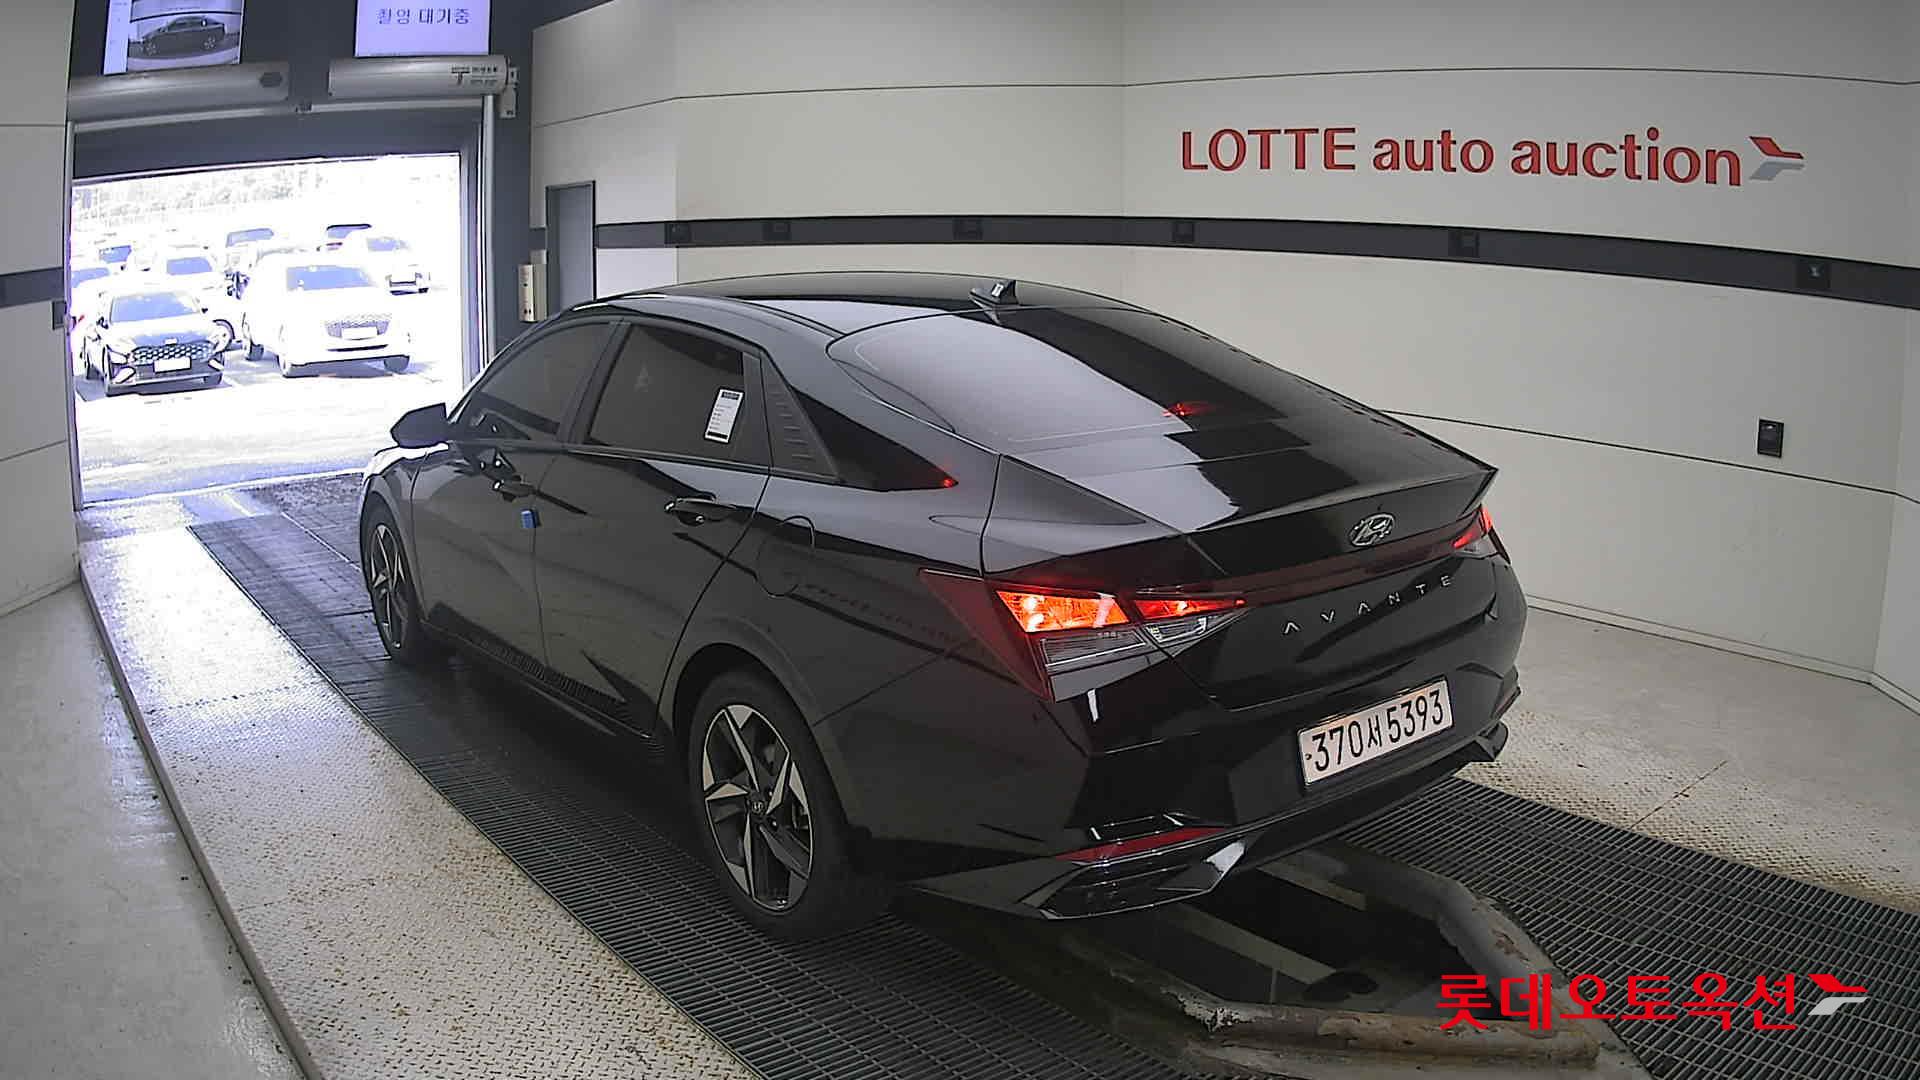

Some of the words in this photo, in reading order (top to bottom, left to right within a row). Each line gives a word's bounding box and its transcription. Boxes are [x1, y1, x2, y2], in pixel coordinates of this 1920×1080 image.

[419, 7, 469, 25] 대기중
[1182, 127, 1356, 172] LOTTE
[1373, 129, 1495, 173] auto
[1511, 127, 1742, 187] auction
[1283, 575, 1452, 634] AVANTE
[1312, 689, 1443, 772] 370서5393
